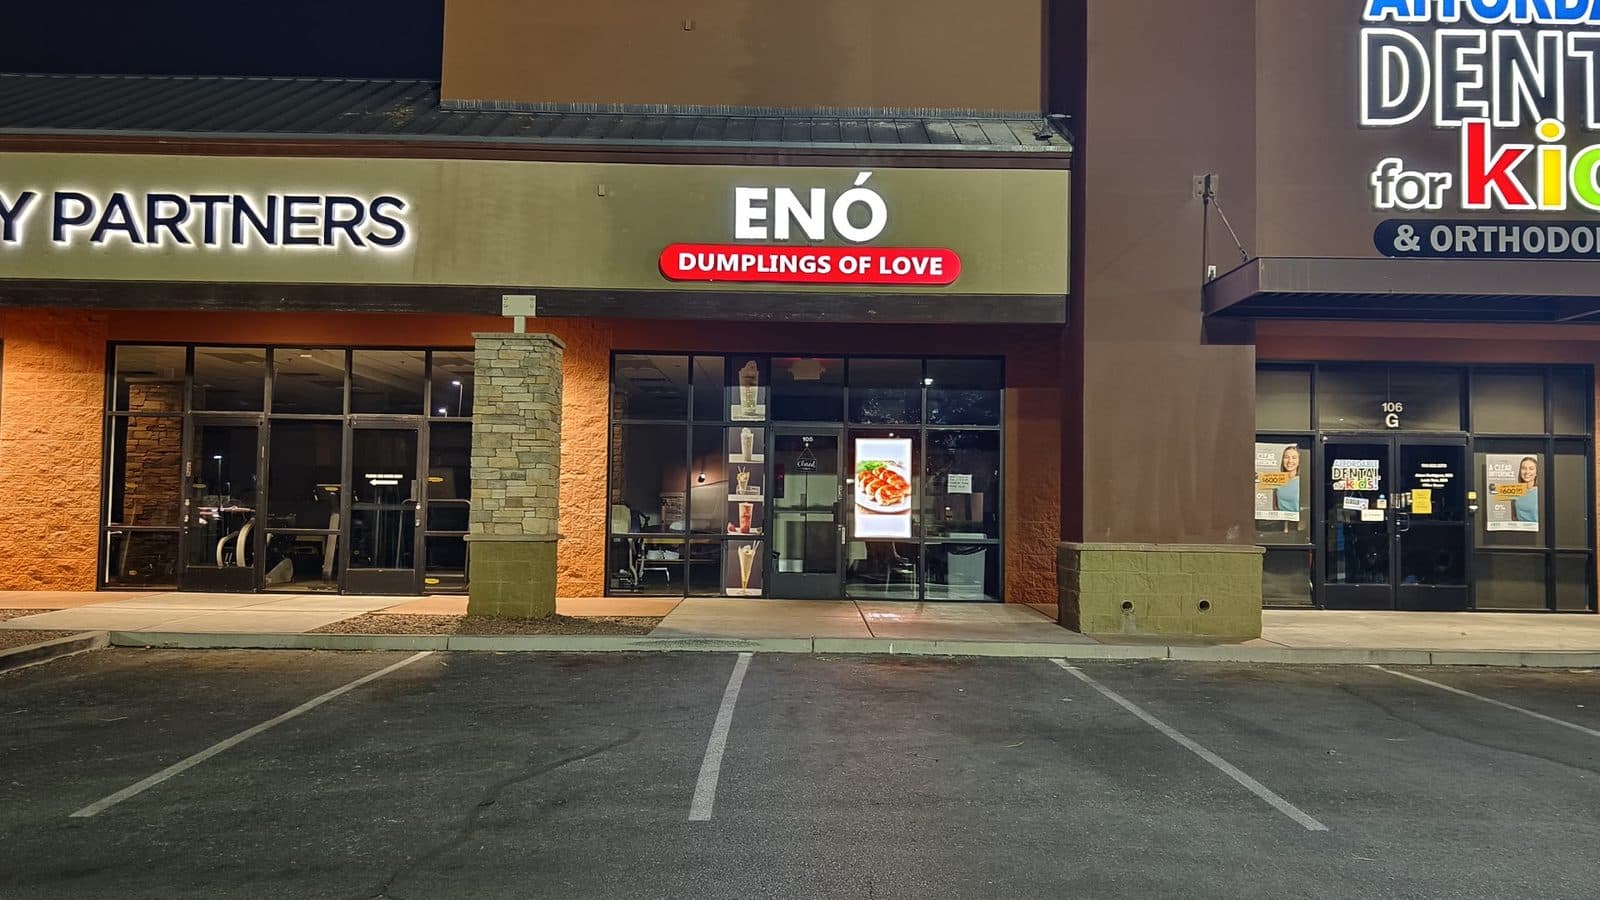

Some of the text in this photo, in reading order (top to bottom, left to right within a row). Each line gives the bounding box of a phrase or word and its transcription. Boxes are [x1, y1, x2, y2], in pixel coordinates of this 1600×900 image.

[1371, 157, 1451, 209] for
[53, 191, 408, 247] PARTNERS
[735, 171, 888, 242] ENÓ
[1393, 224, 1600, 253] & ORTHODO
[678, 252, 944, 276] DUMPLINGS OF LOVE
[1381, 402, 1404, 413] 106
[1385, 413, 1399, 428] G
[1333, 467, 1379, 479] DENTAL
